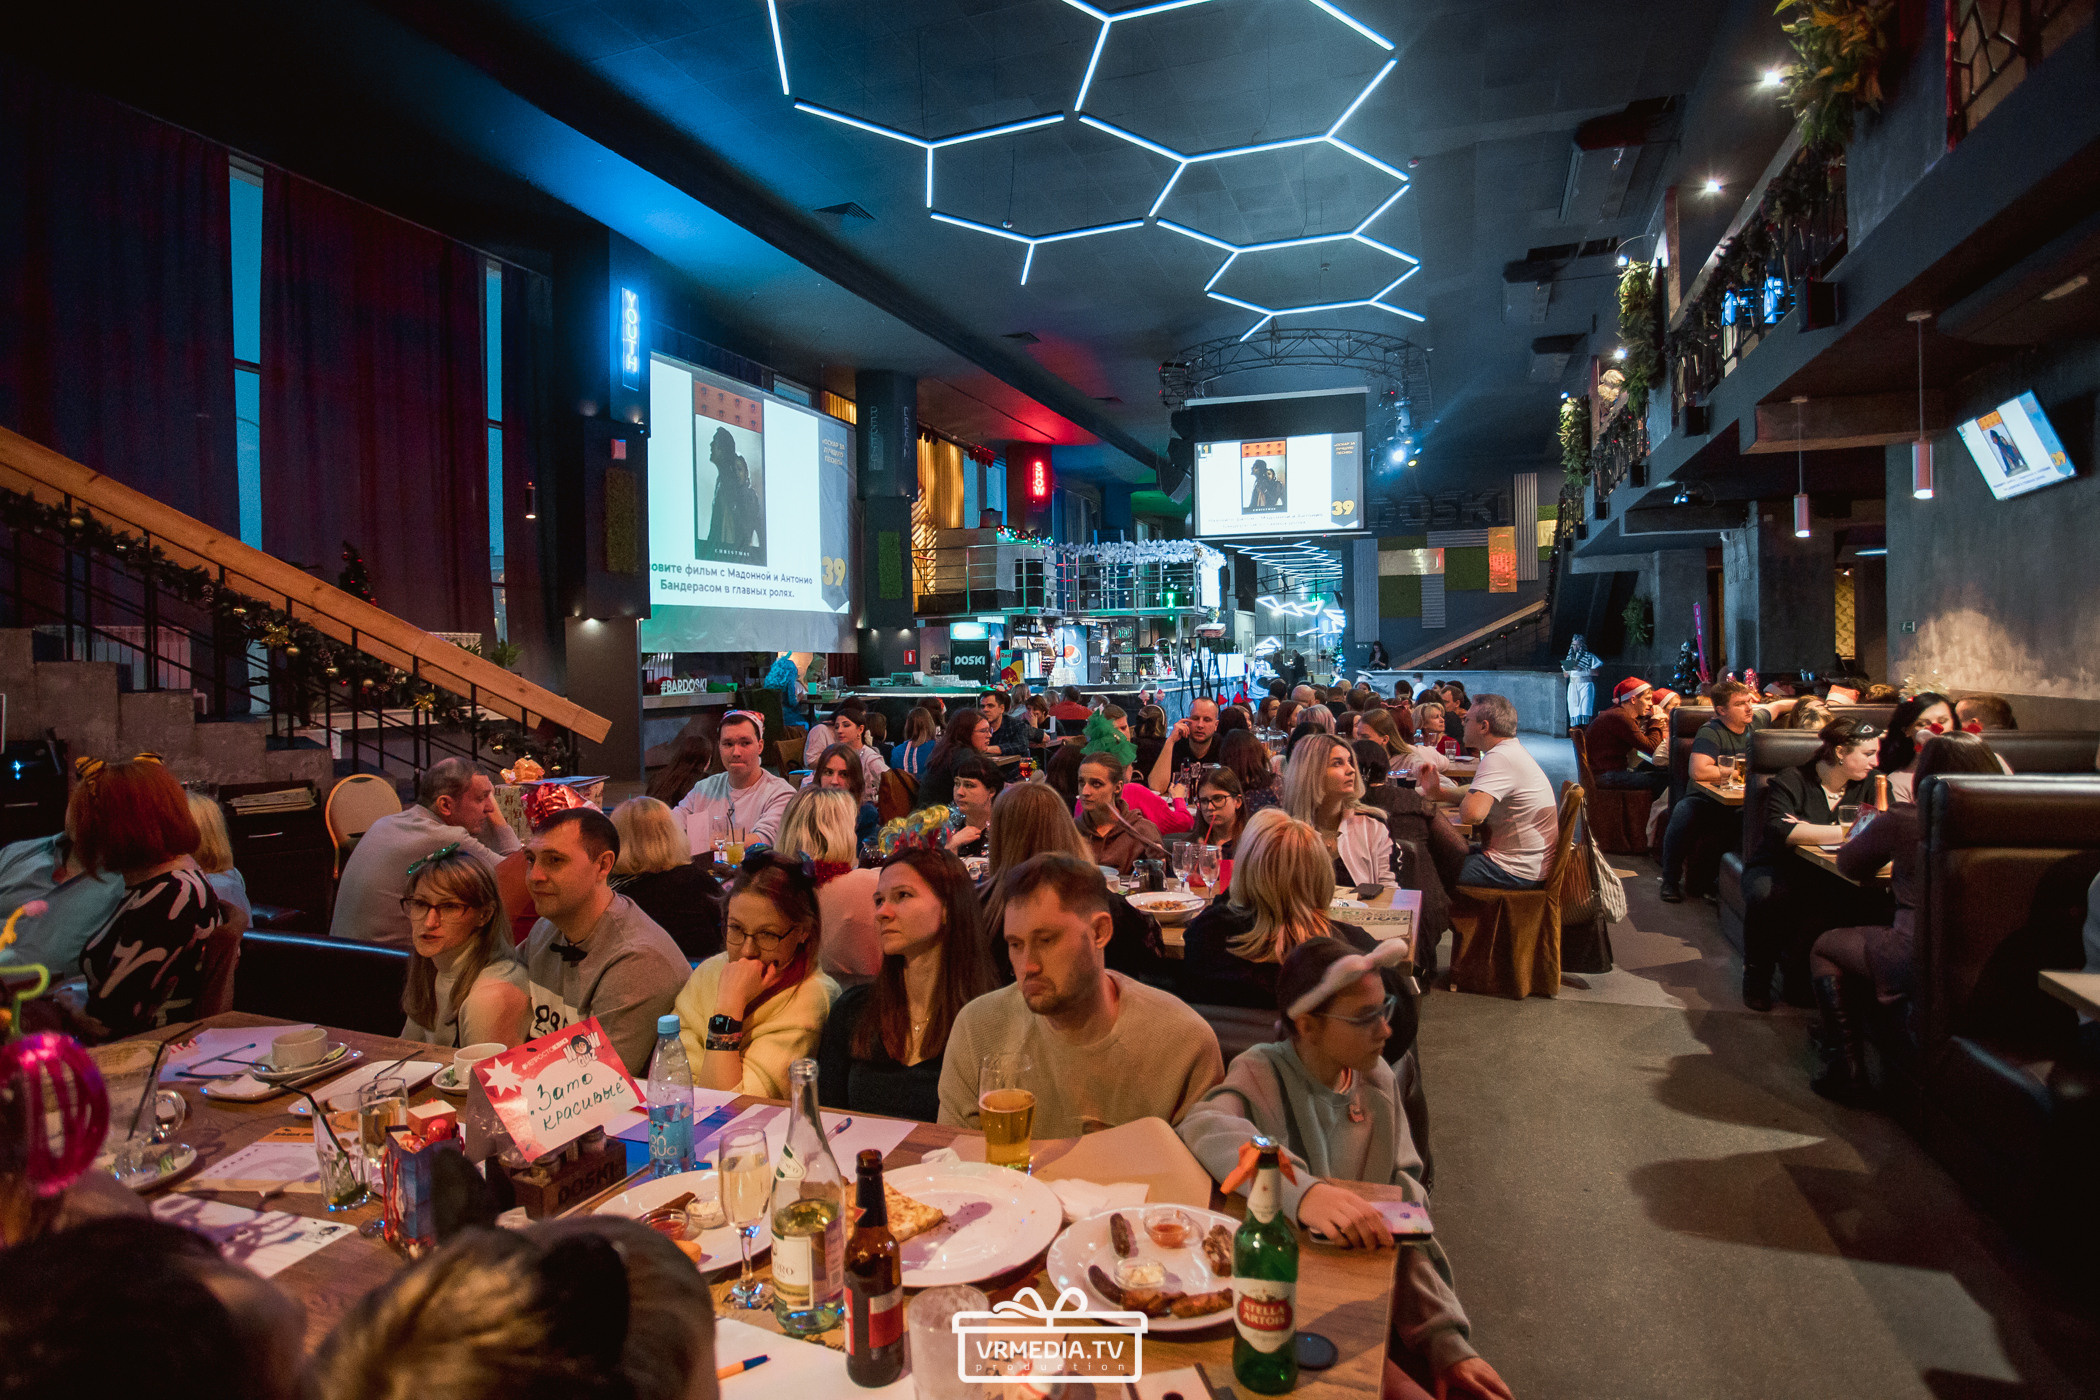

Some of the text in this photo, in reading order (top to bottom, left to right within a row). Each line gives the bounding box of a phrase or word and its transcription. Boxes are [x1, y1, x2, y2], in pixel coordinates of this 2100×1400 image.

[625, 289, 638, 373] YOUTH
[1033, 461, 1045, 496] SHOW
[1331, 499, 1355, 516] 39
[651, 562, 813, 585] овите фильм с Мадонной и Антонио
[821, 555, 846, 587] 39
[660, 579, 795, 599] Бандерасом в главных ролях.
[954, 655, 986, 666] DOSKI
[660, 677, 708, 695] #BARDOSKI
[1243, 1301, 1285, 1315] STELLA
[1243, 1311, 1286, 1327] ARTOIS
